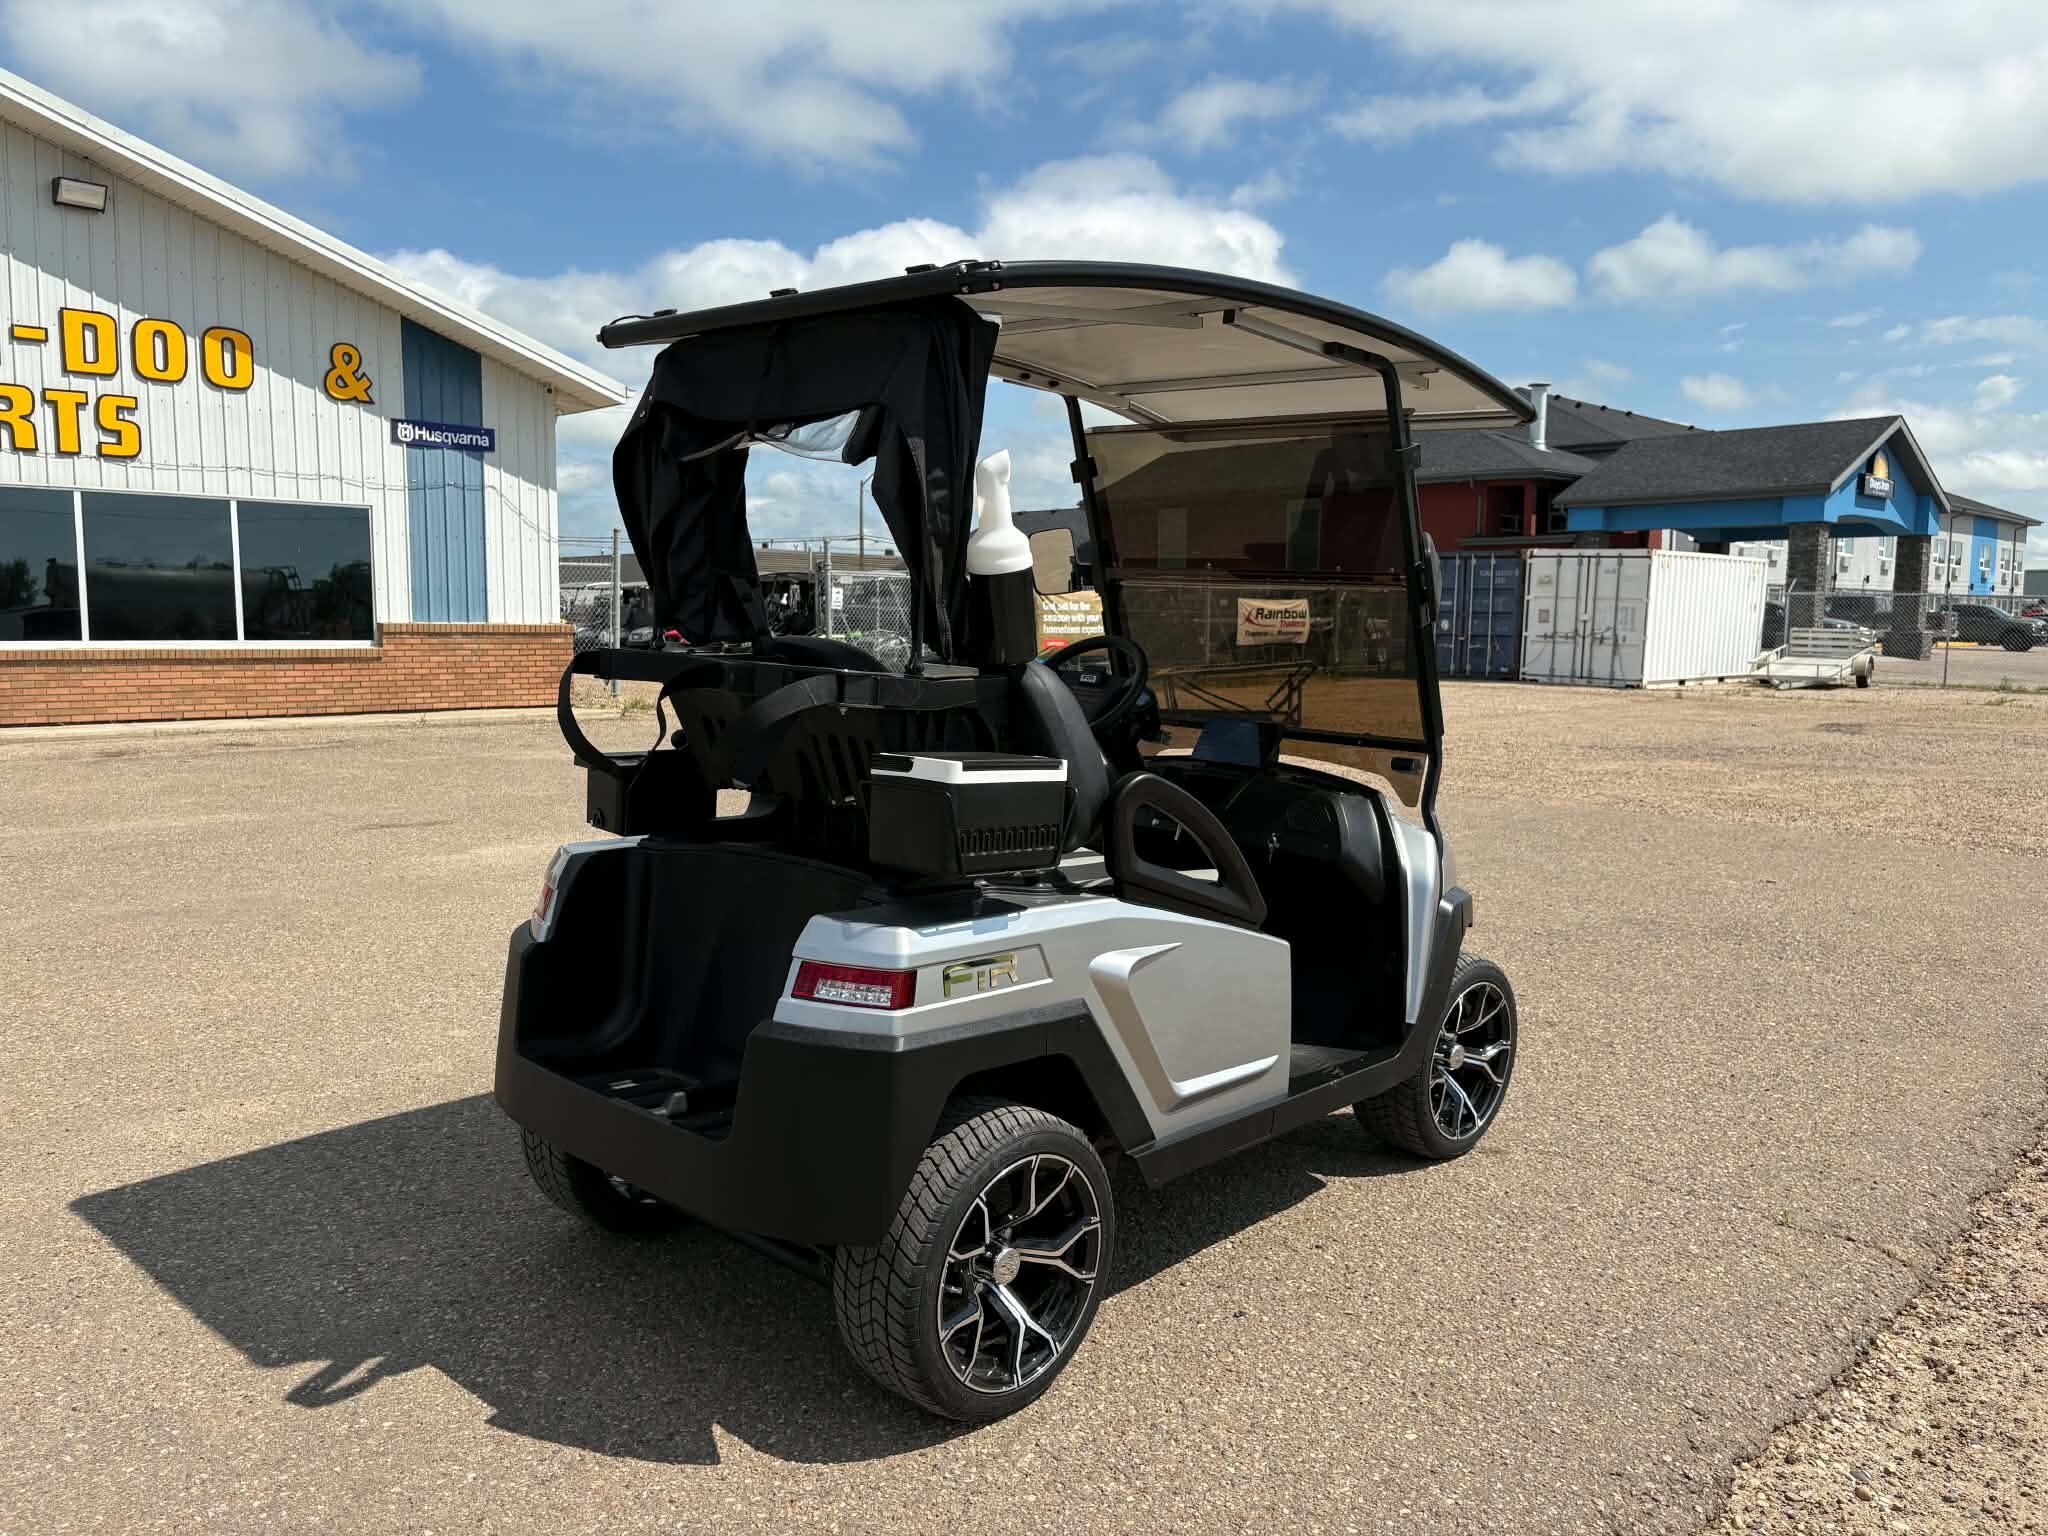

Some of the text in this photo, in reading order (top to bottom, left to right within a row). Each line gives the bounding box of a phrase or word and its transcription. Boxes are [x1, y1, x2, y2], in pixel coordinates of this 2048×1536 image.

[324, 342, 375, 405] &
[0, 383, 142, 459] RTS
[414, 425, 490, 448] Husqvarna
[1255, 607, 1308, 620] Rainbow
